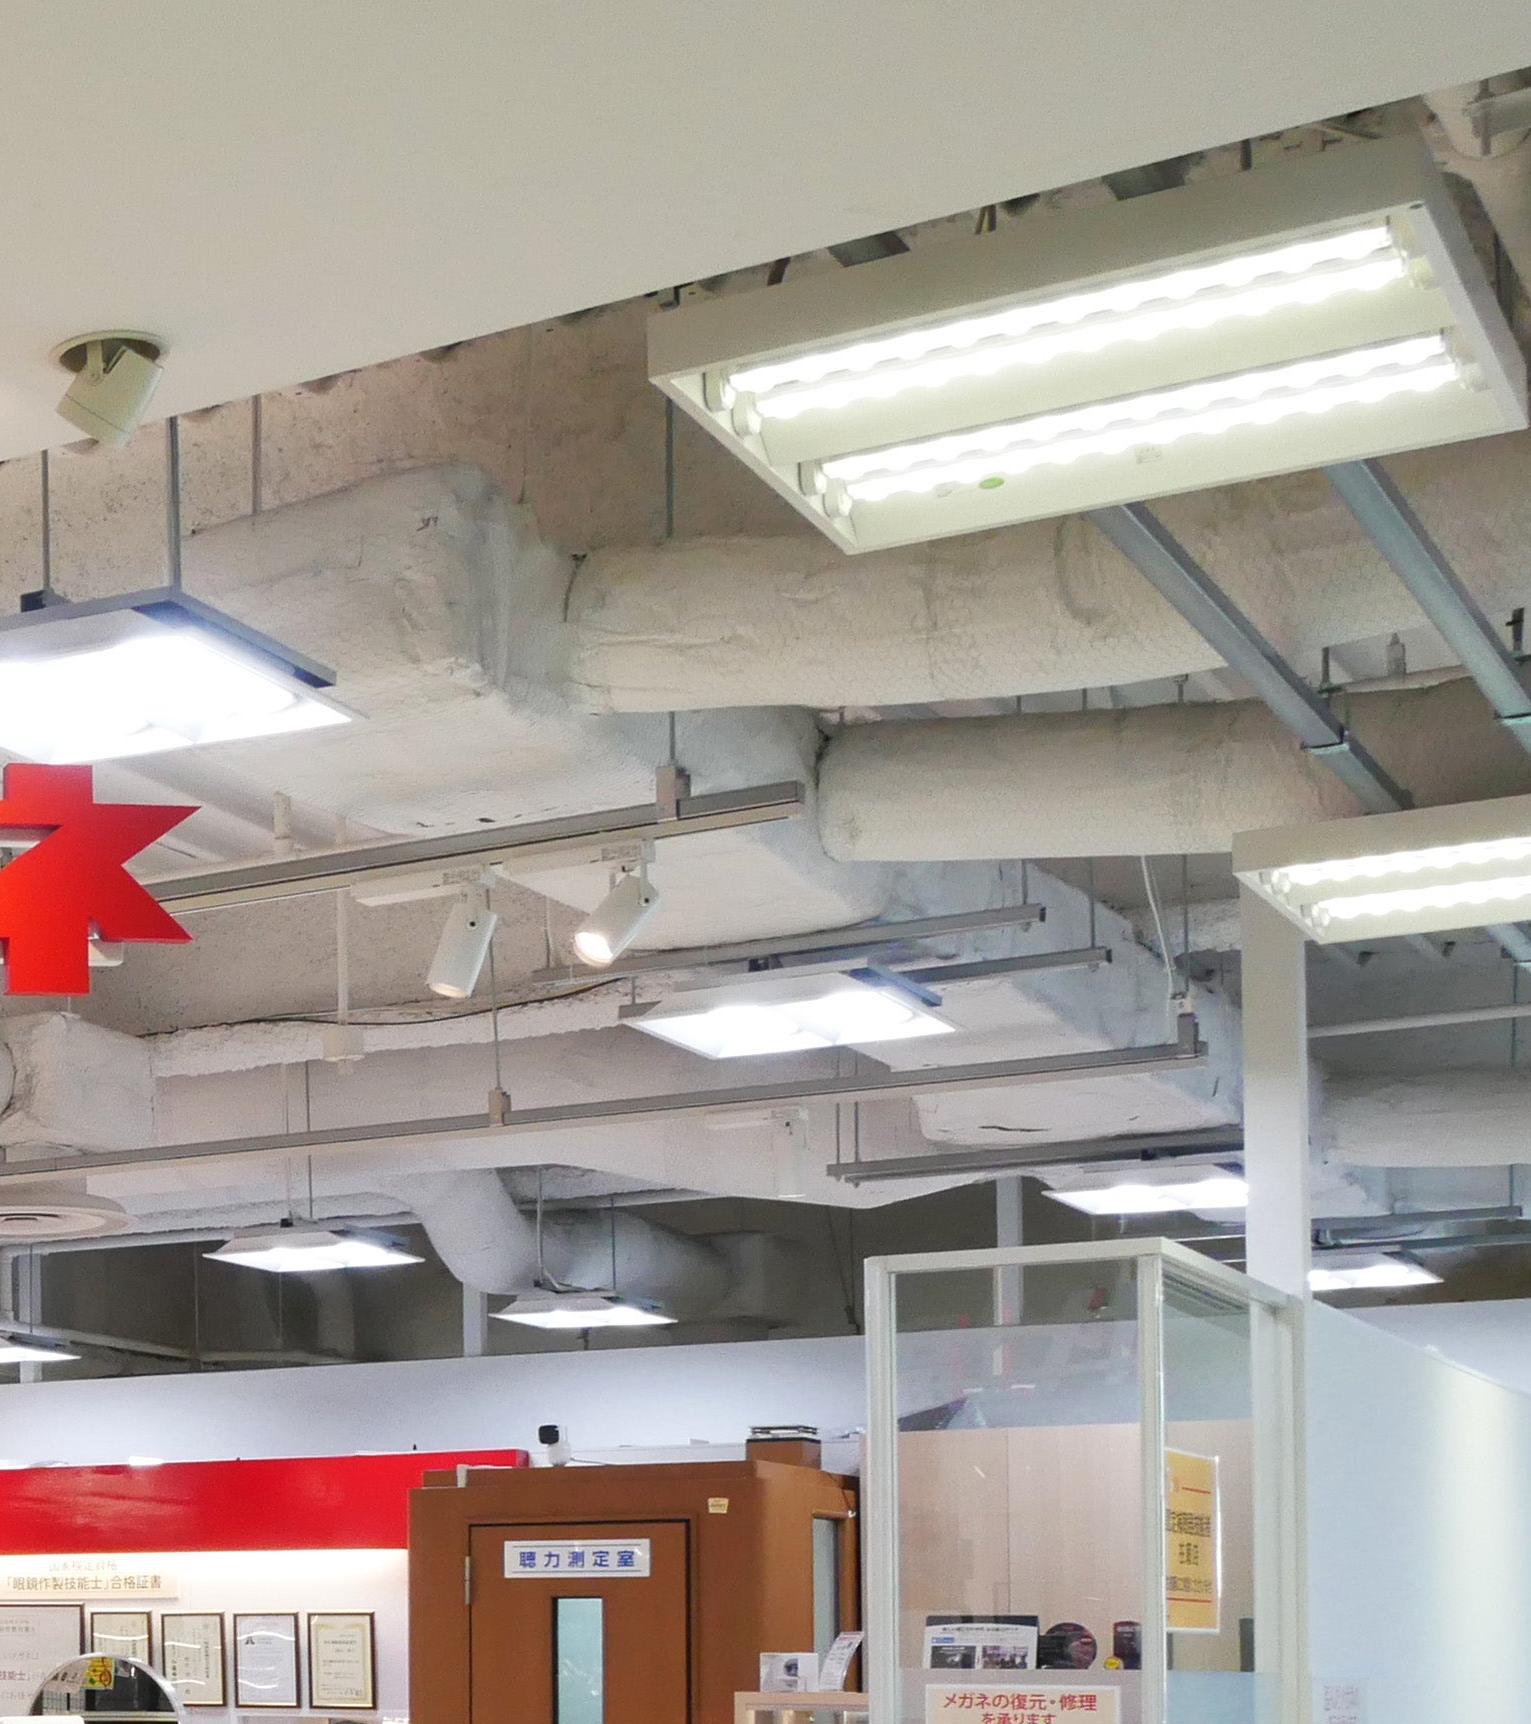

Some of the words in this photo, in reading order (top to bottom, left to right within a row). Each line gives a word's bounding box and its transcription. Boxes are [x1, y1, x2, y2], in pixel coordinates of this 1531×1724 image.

[519, 1550, 635, 1568] 聴力測定室
[943, 1692, 1098, 1711] メガネの復元・修理
